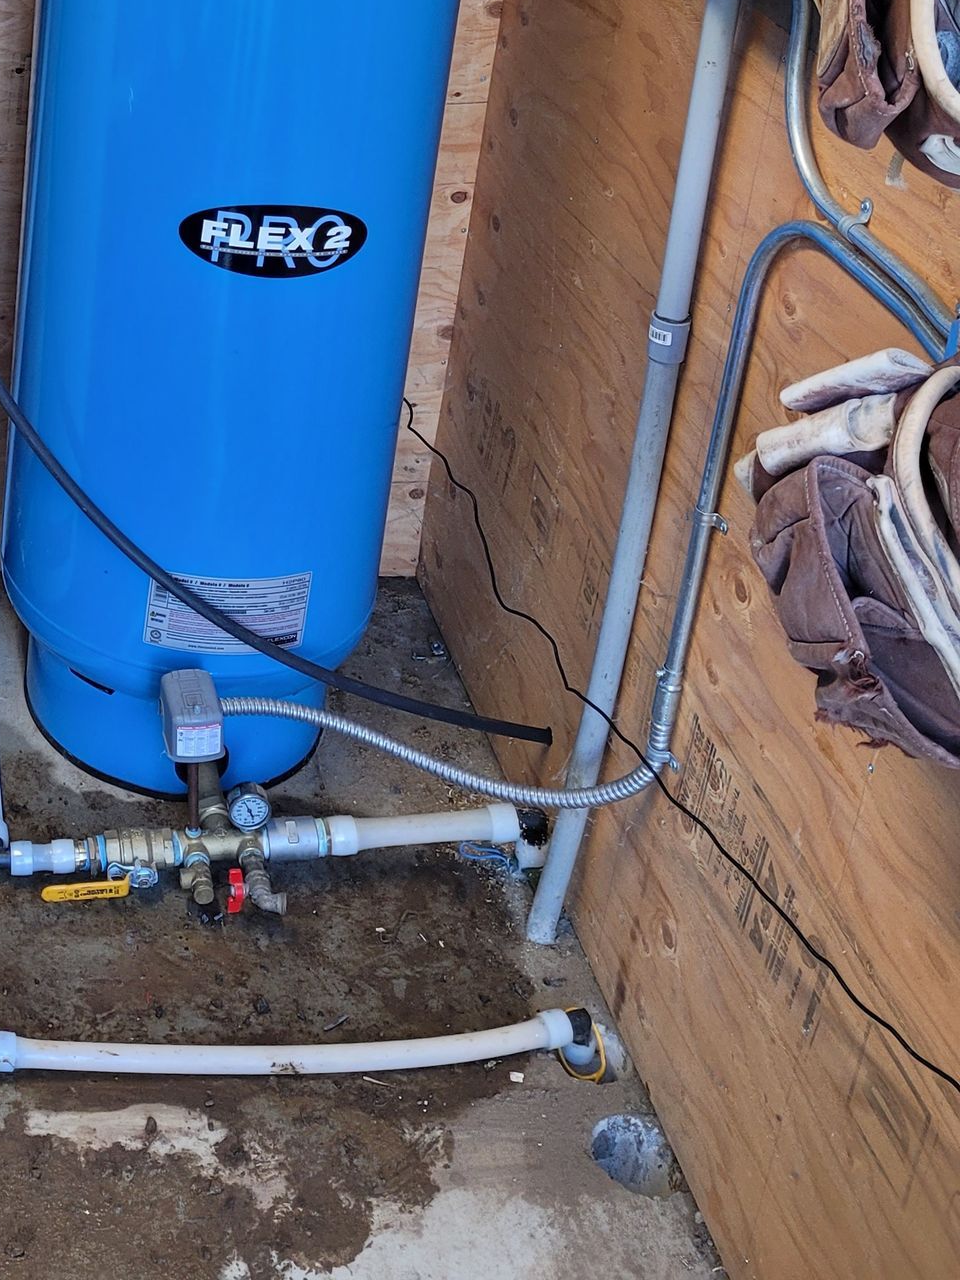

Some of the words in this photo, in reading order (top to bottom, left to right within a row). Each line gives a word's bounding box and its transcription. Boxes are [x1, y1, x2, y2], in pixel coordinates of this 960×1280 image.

[200, 219, 315, 251] FLEX
[323, 225, 352, 250] 2
[210, 210, 346, 269] PRO
